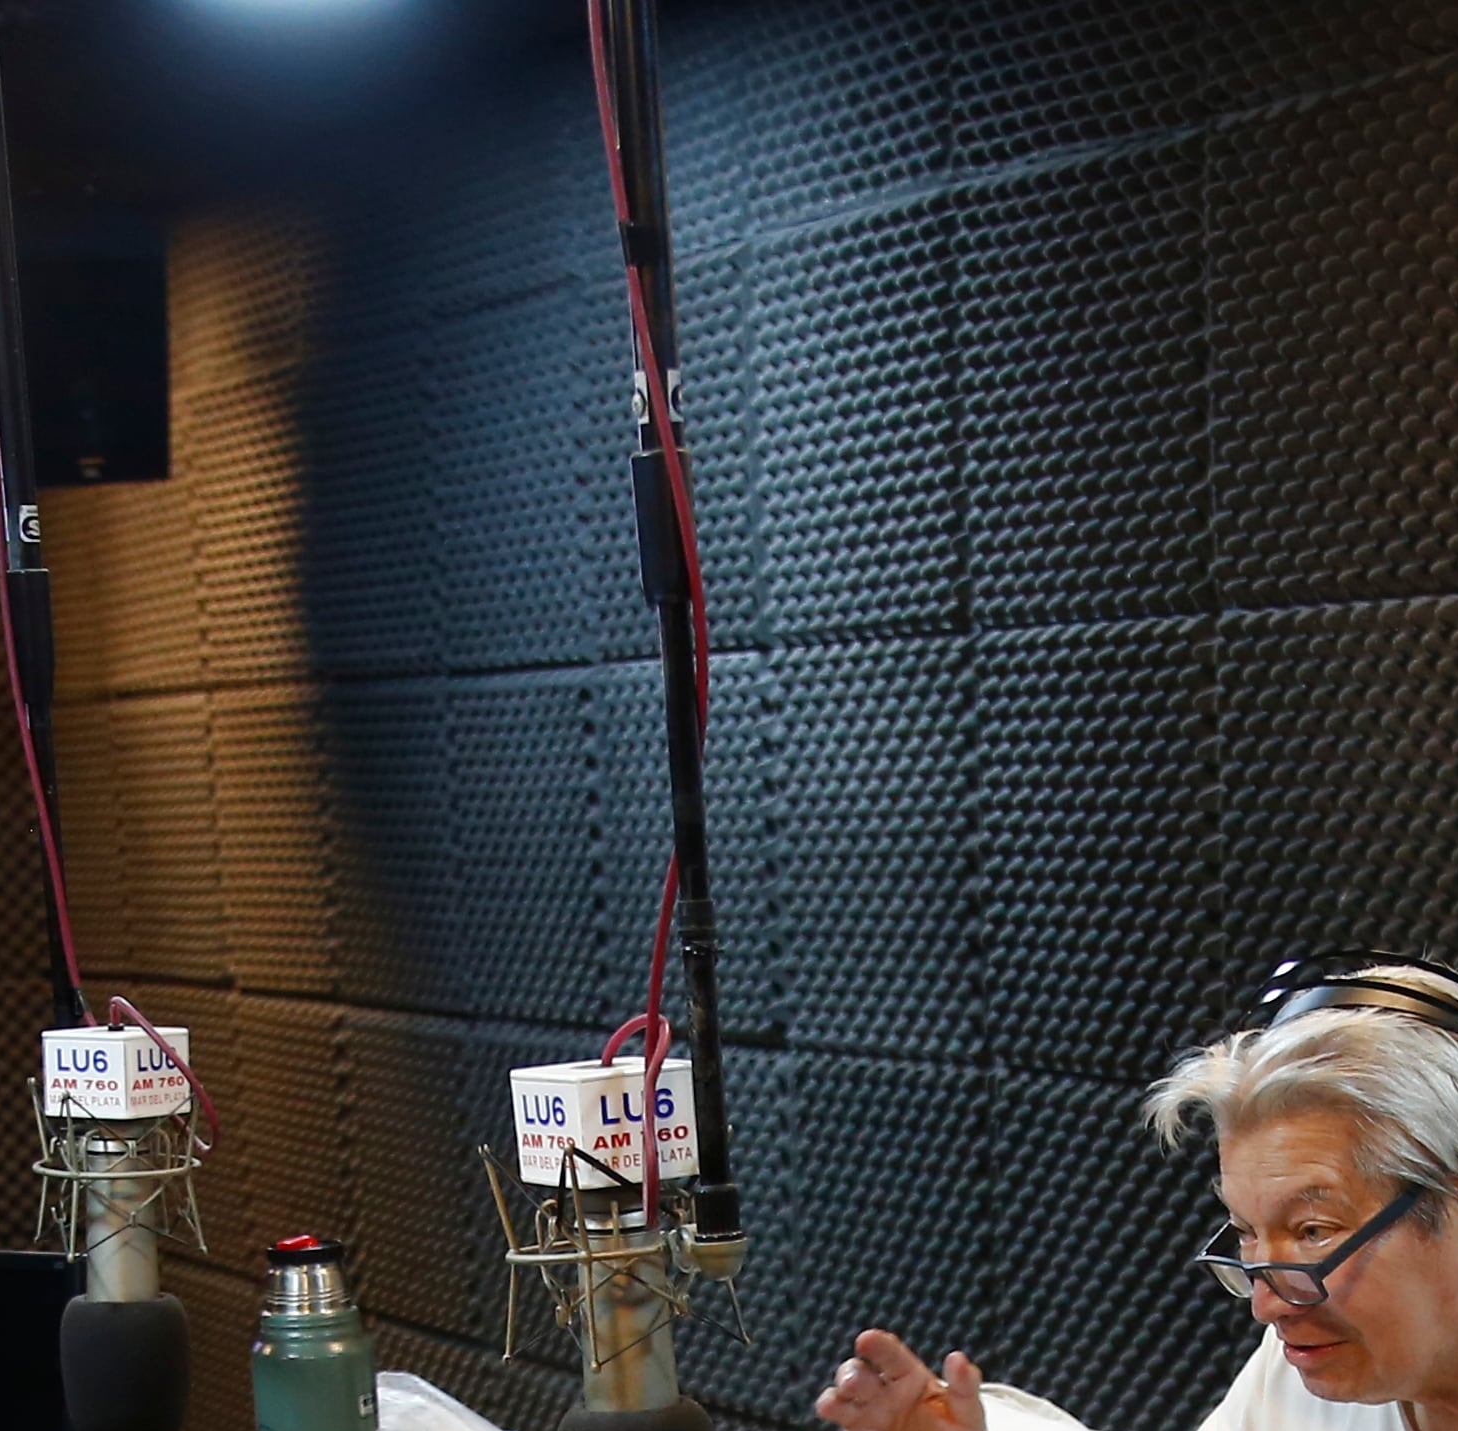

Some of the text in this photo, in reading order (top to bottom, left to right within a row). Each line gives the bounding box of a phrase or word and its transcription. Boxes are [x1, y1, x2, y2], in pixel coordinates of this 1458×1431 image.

[56, 1047, 109, 1073] LU6
[136, 1046, 179, 1072] LU6
[51, 1077, 119, 1092] AM 760
[131, 1075, 186, 1092] AM 760
[521, 1093, 567, 1127] LU6
[599, 1088, 675, 1127] LU6
[521, 1132, 544, 1148] AM
[593, 1125, 690, 1151] AM 60
[656, 1146, 694, 1164] LATA
